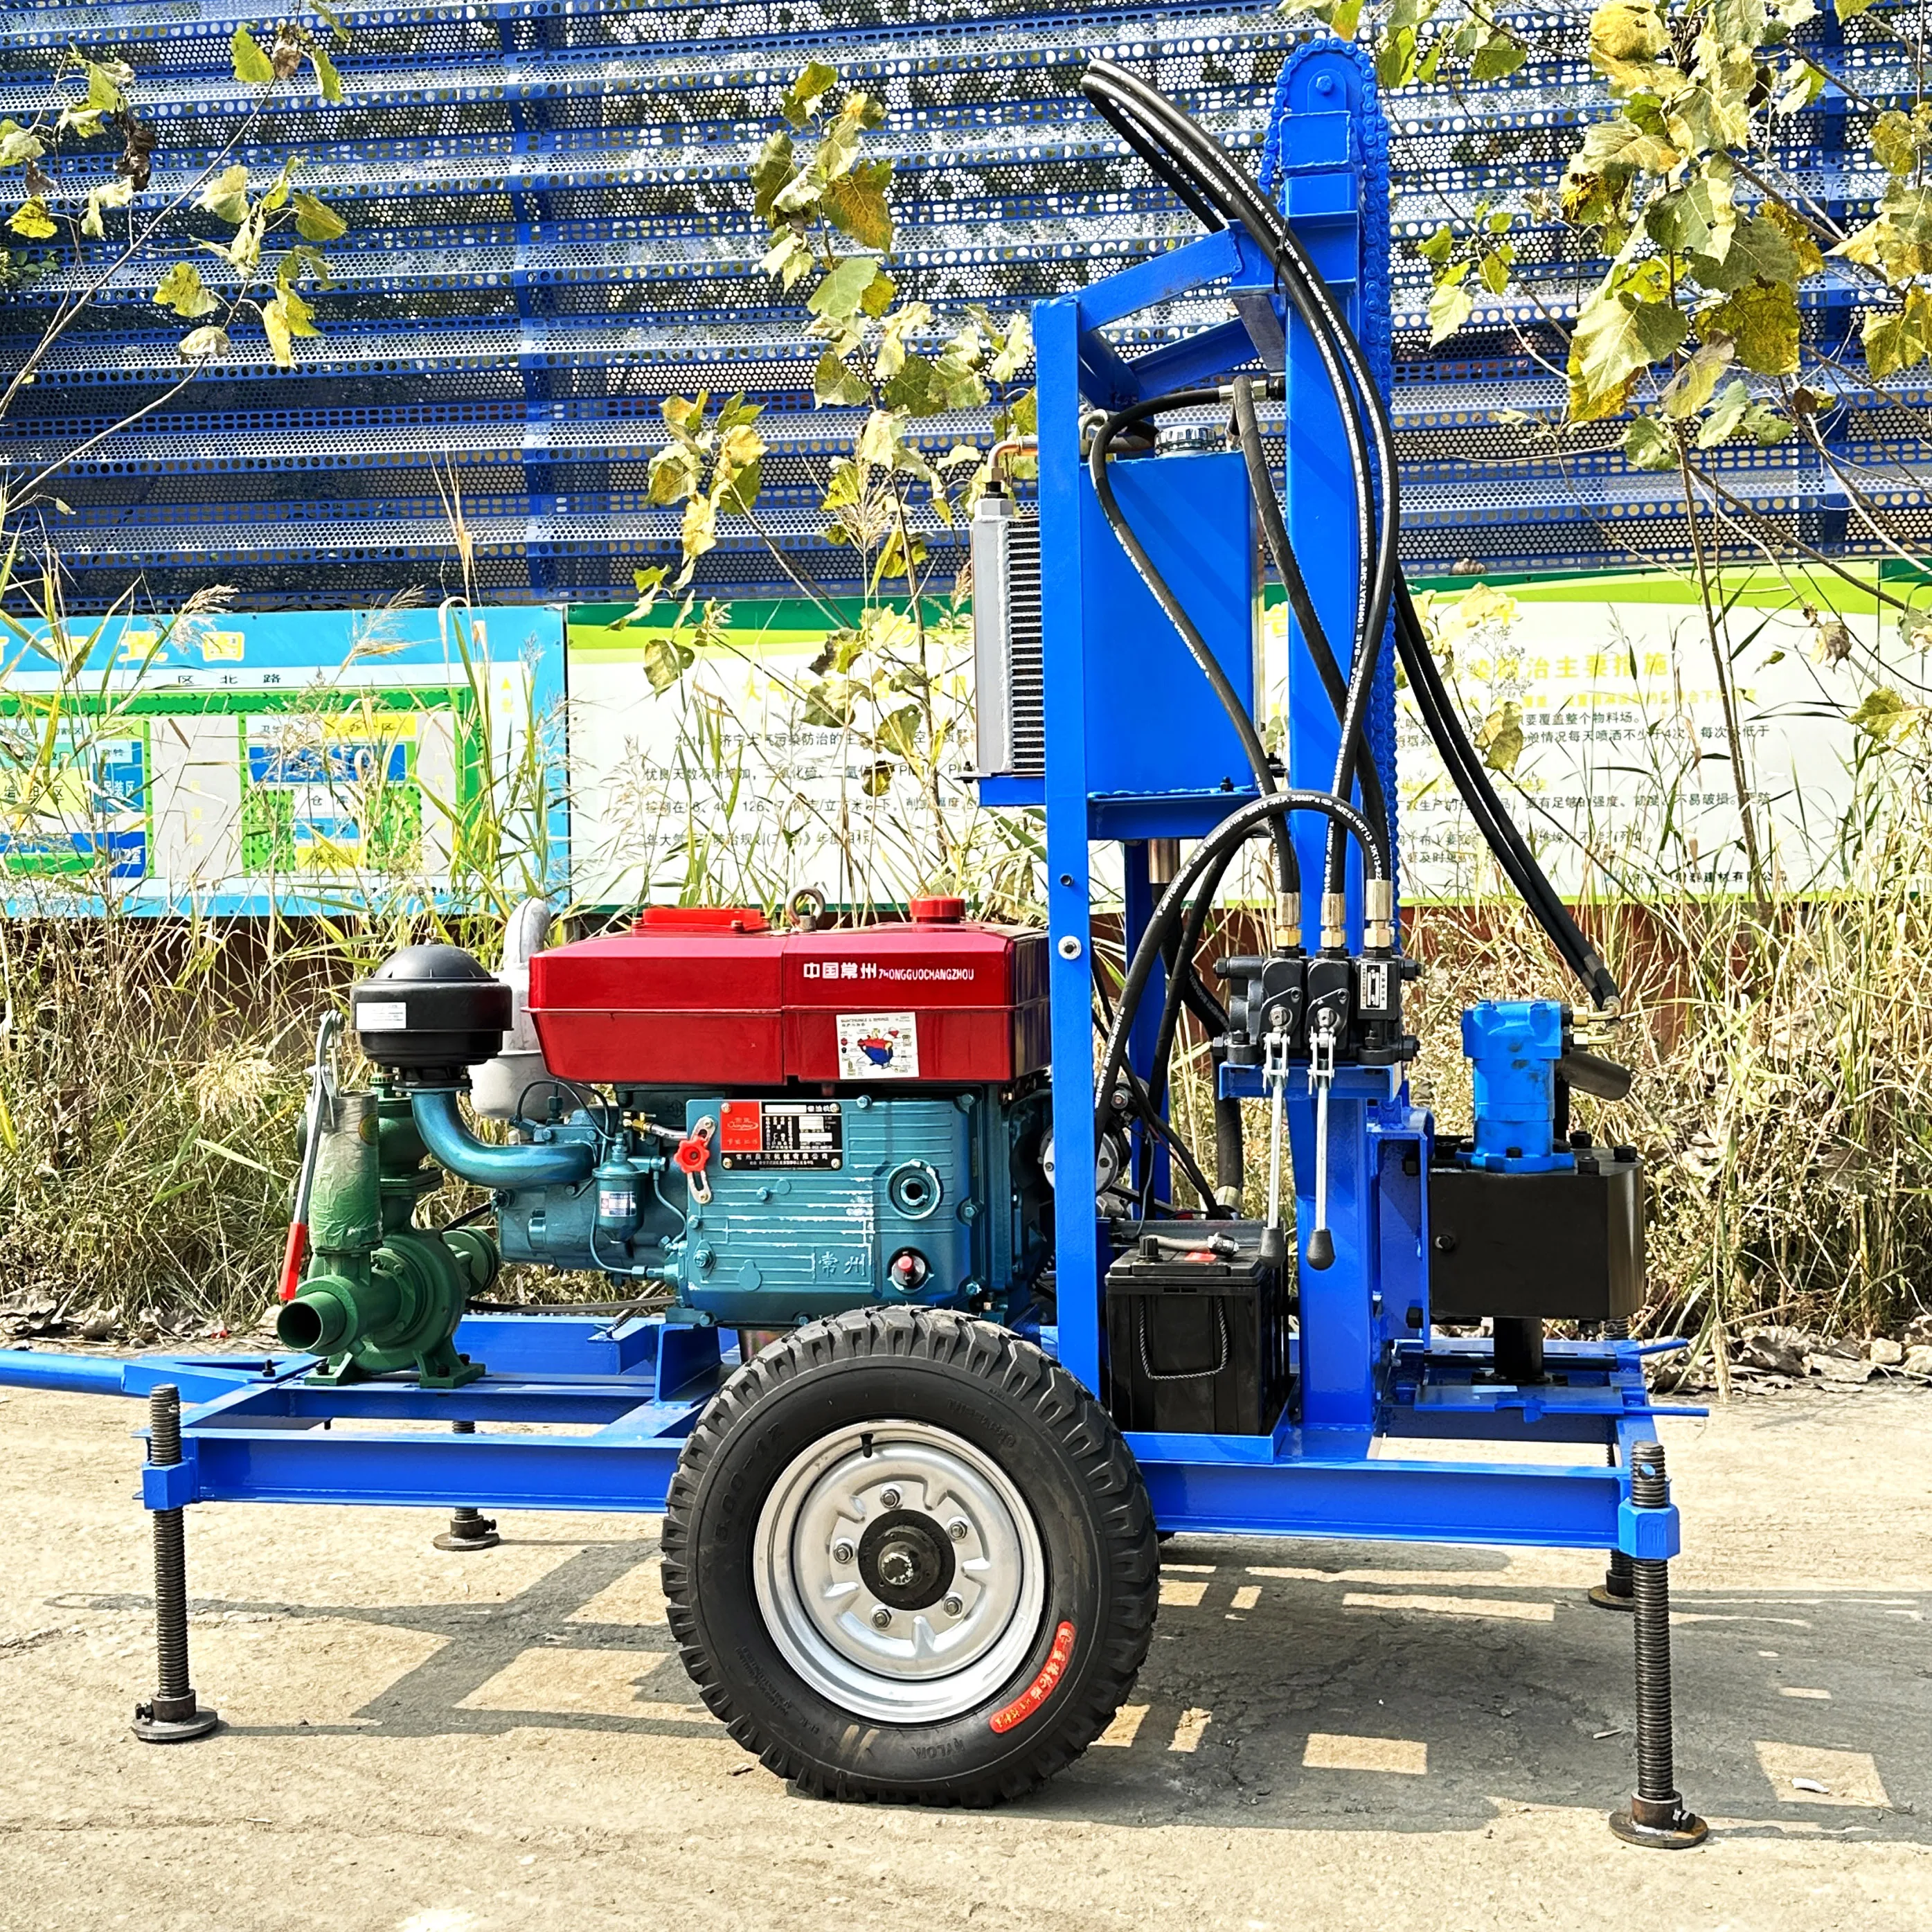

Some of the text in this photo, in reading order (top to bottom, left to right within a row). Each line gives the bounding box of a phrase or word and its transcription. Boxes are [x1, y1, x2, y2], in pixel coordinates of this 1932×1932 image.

[1179, 147, 1231, 194] JINTONGDA
[803, 962, 877, 979] 中国常州
[819, 1251, 866, 1276] 常州
[911, 1737, 965, 1759] NYLON
